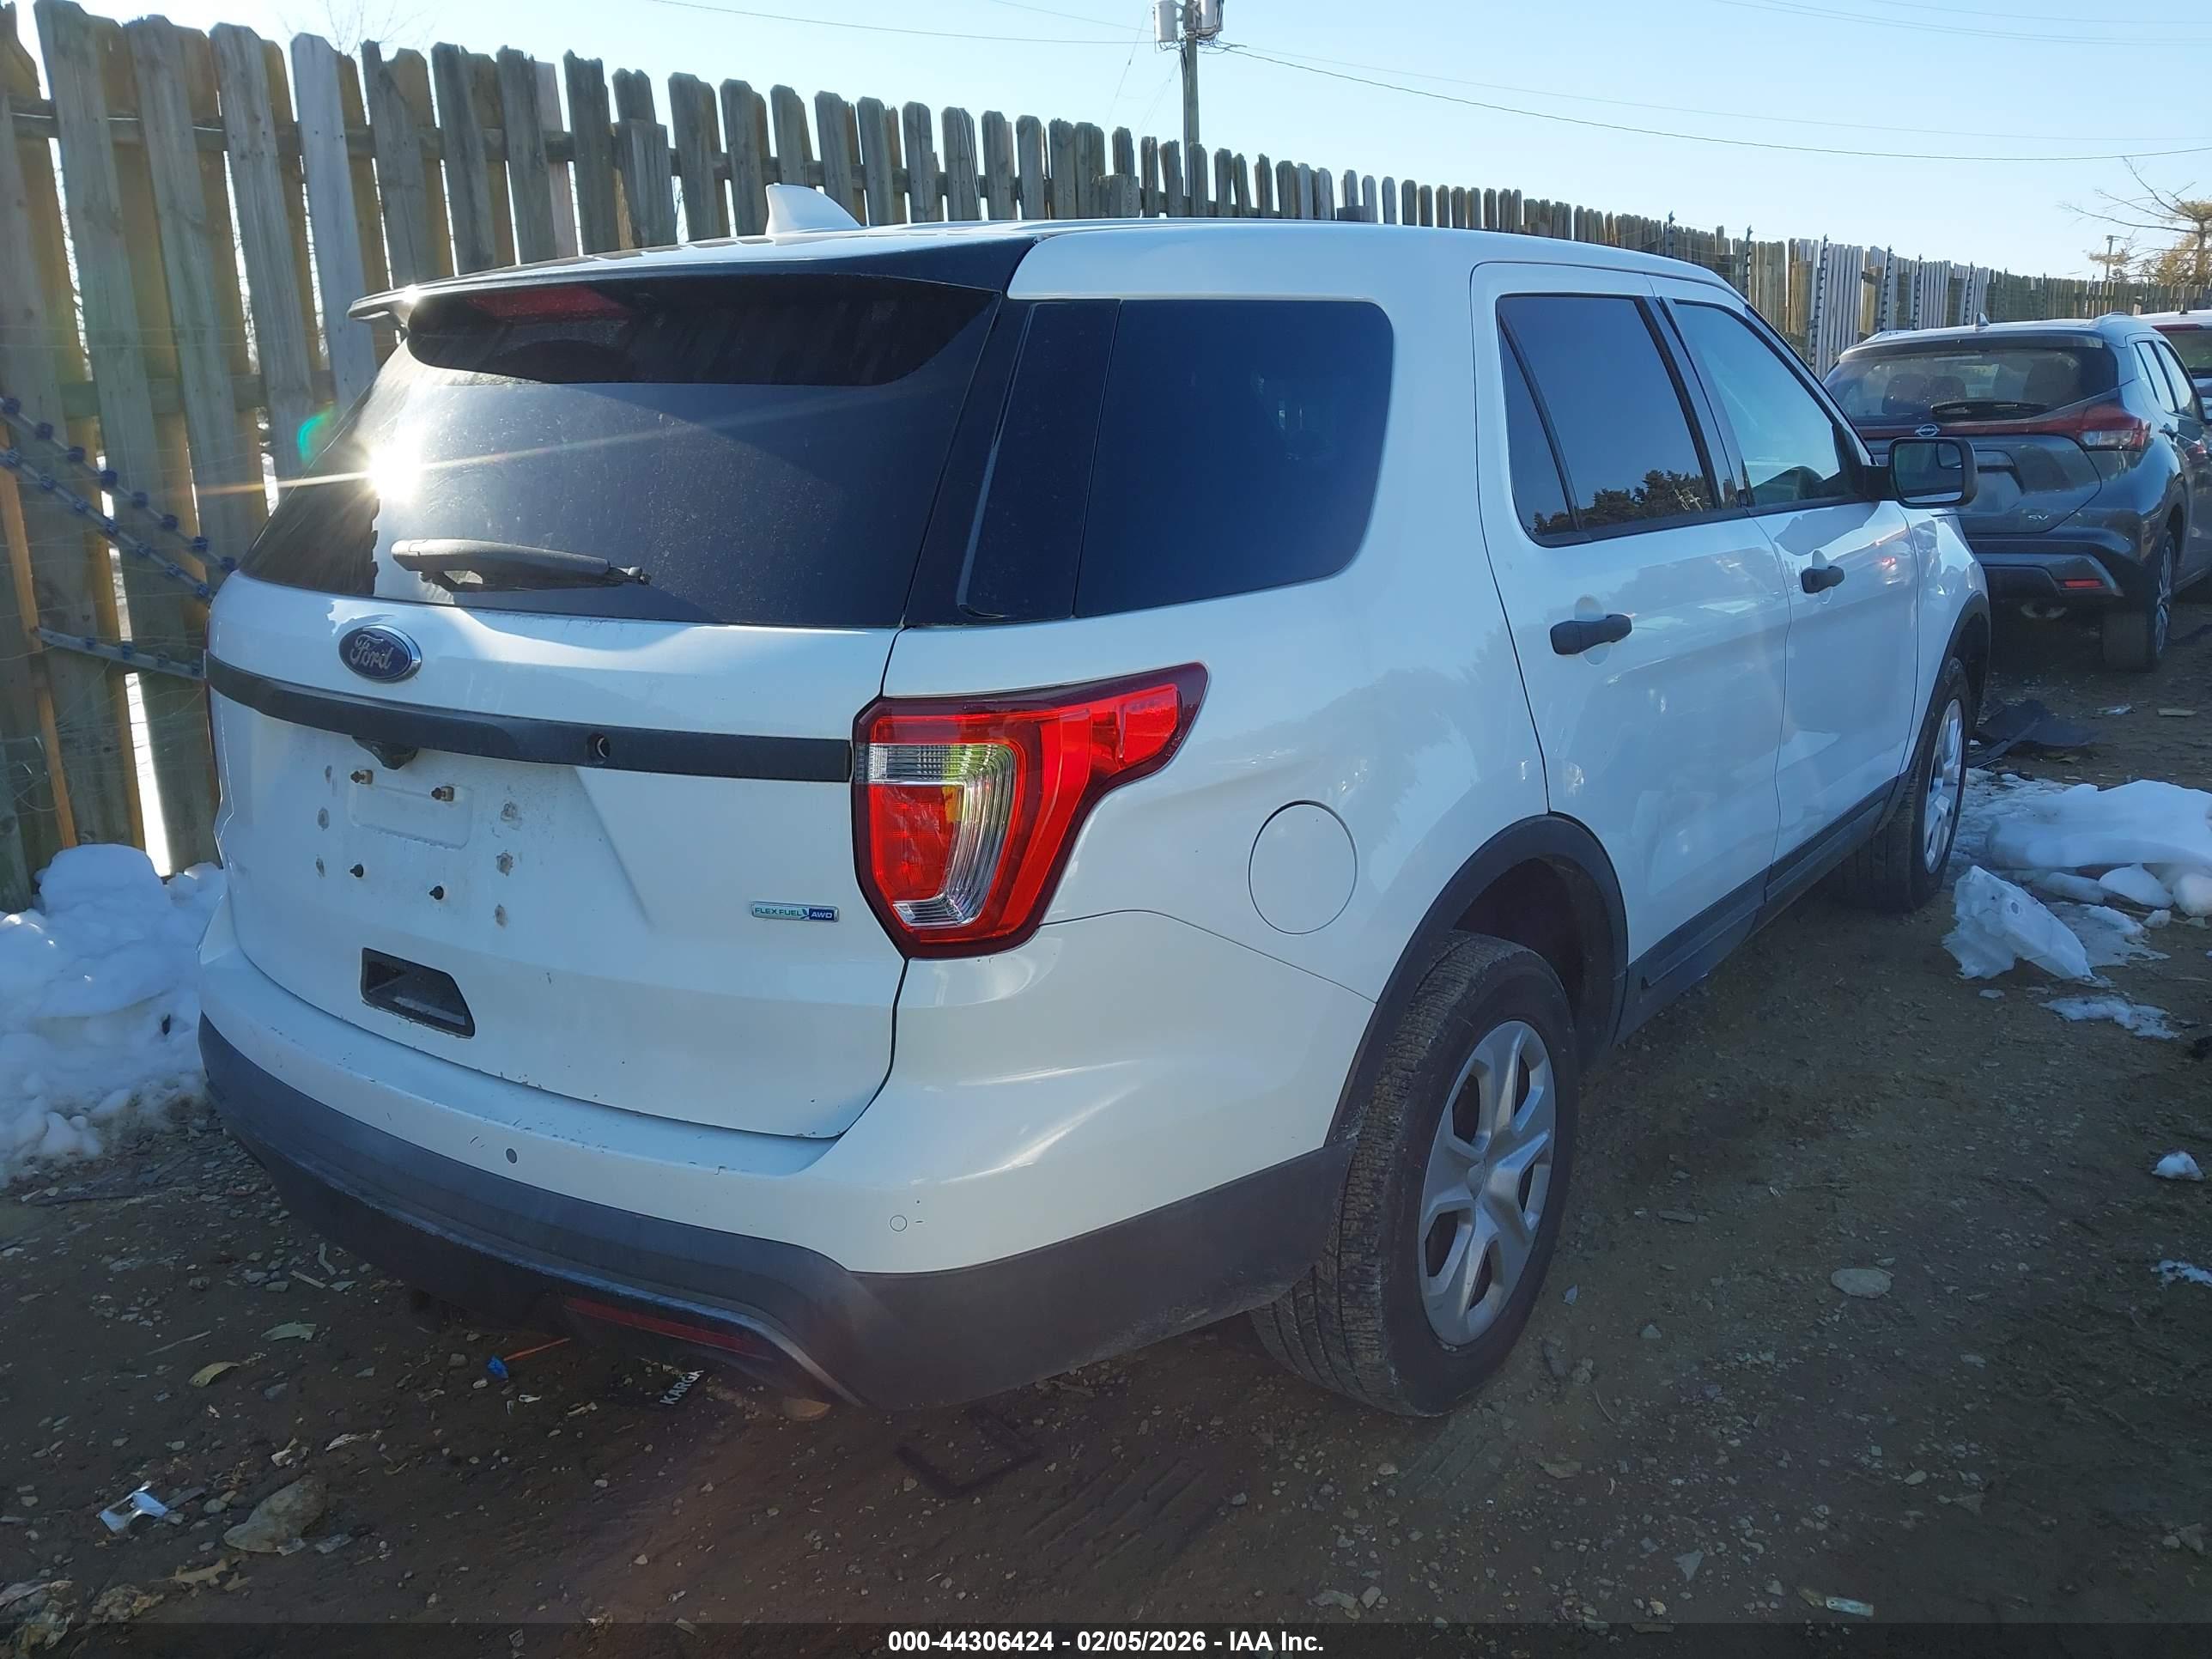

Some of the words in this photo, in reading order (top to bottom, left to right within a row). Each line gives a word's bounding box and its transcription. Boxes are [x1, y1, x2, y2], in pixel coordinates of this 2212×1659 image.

[349, 634, 394, 670] Ford
[756, 907, 777, 915] FLEX
[778, 908, 803, 917] FUEL
